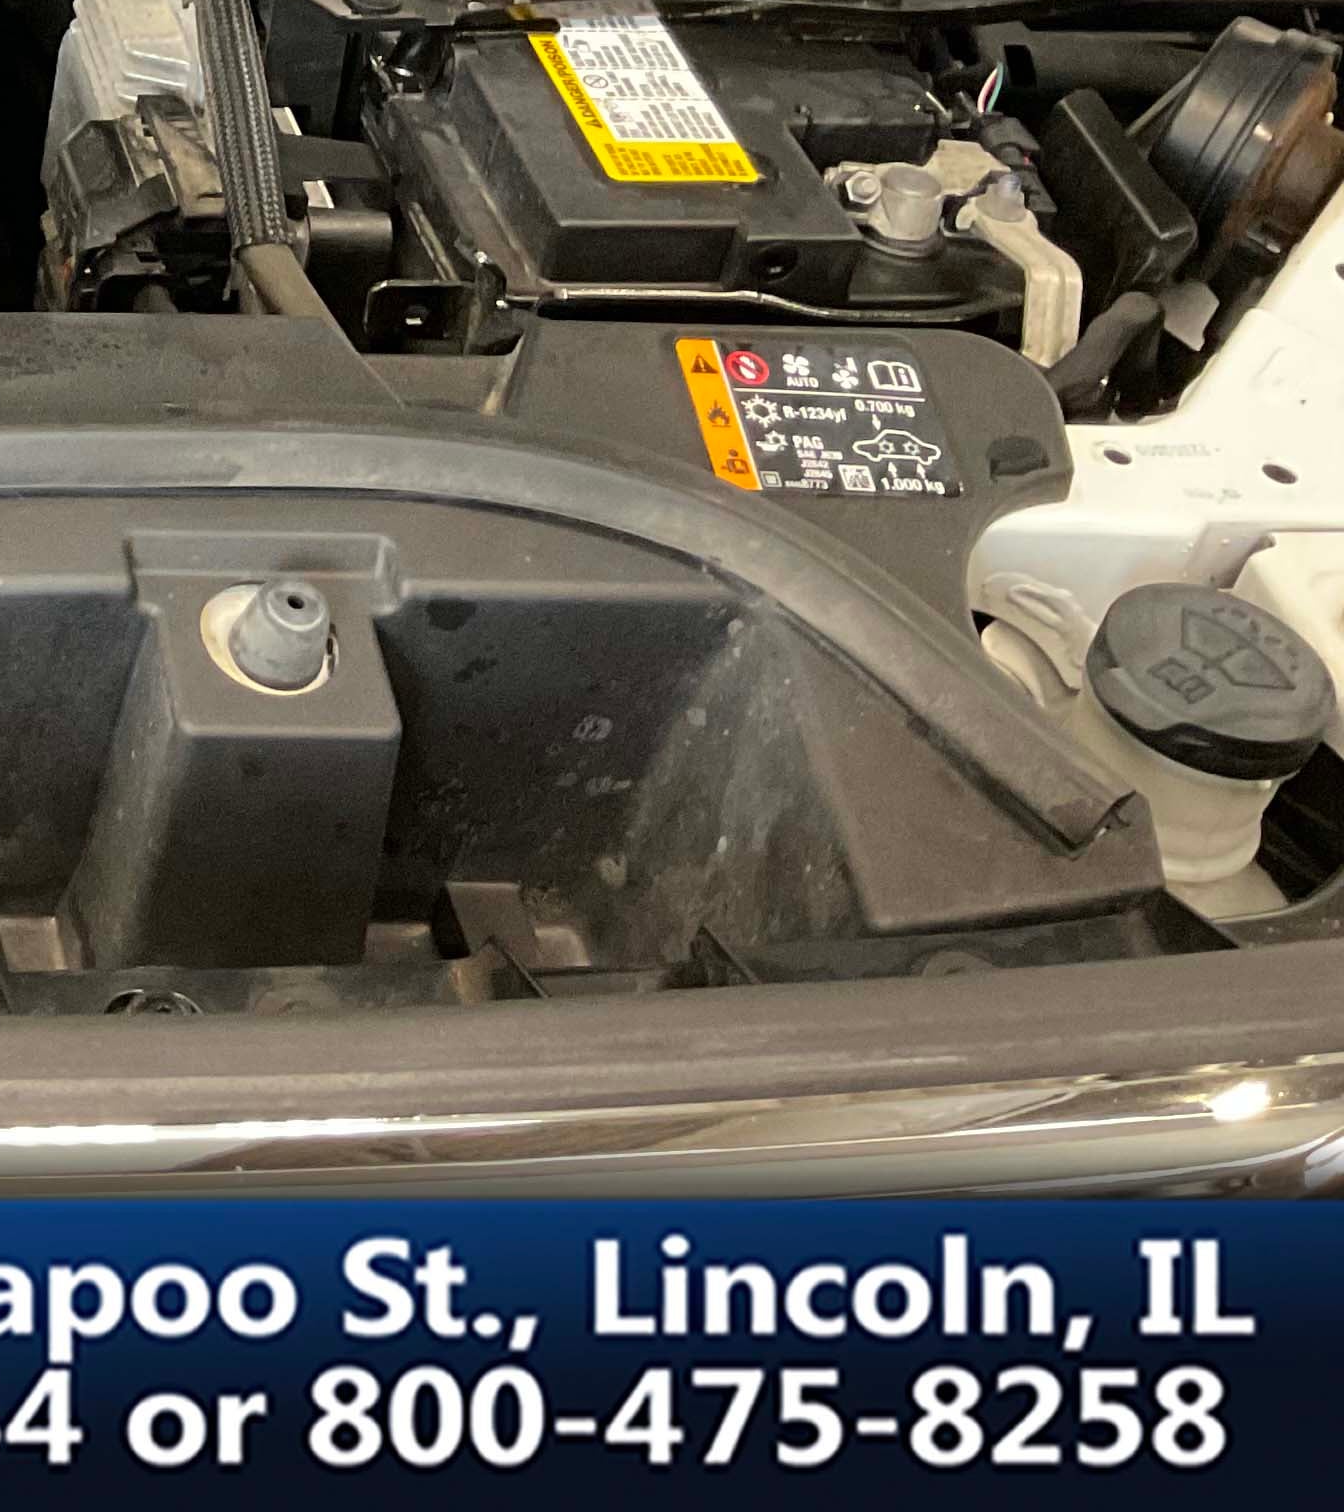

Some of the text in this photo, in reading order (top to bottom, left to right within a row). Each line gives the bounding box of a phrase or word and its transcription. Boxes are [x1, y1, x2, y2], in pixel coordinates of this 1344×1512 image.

[787, 377, 819, 388] AUTO
[854, 399, 916, 418] 0.700 kg
[792, 435, 825, 450] PAG
[881, 477, 946, 495] 1.000 kg
